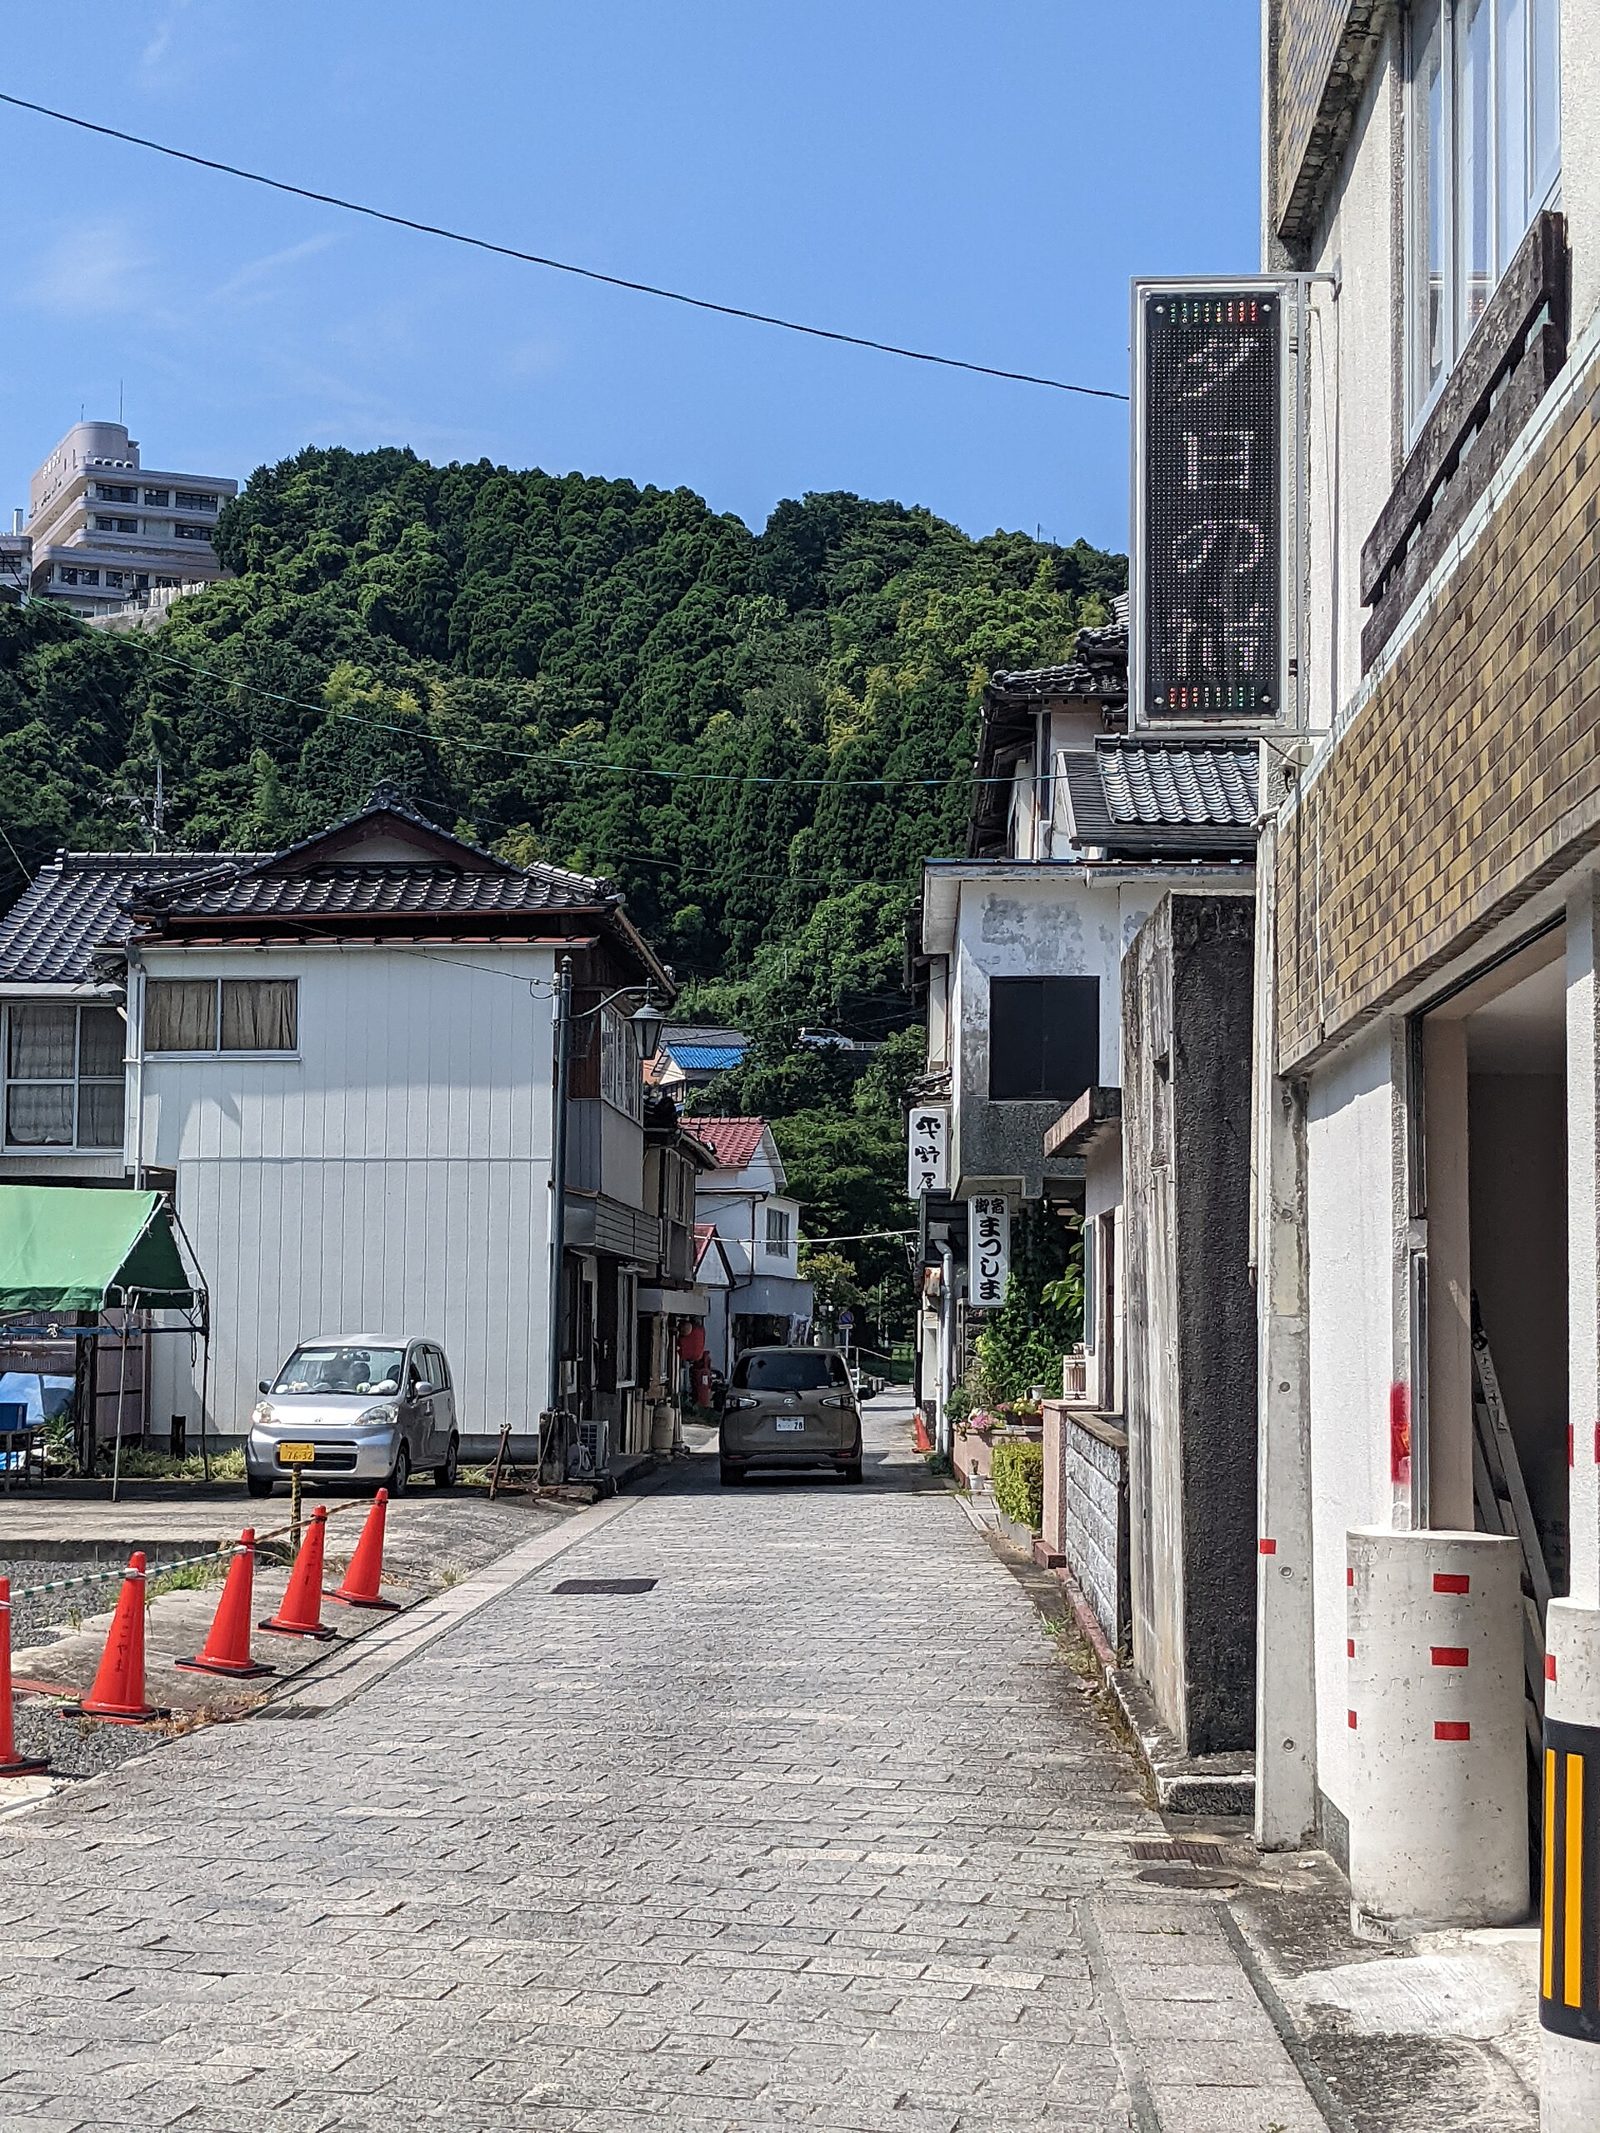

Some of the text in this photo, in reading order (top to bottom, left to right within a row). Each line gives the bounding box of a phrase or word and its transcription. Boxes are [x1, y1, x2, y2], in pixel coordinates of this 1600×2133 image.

[914, 1115, 942, 1190] 平野屋
[975, 1198, 1005, 1214] 御宿
[978, 1216, 1002, 1300] まつしま
